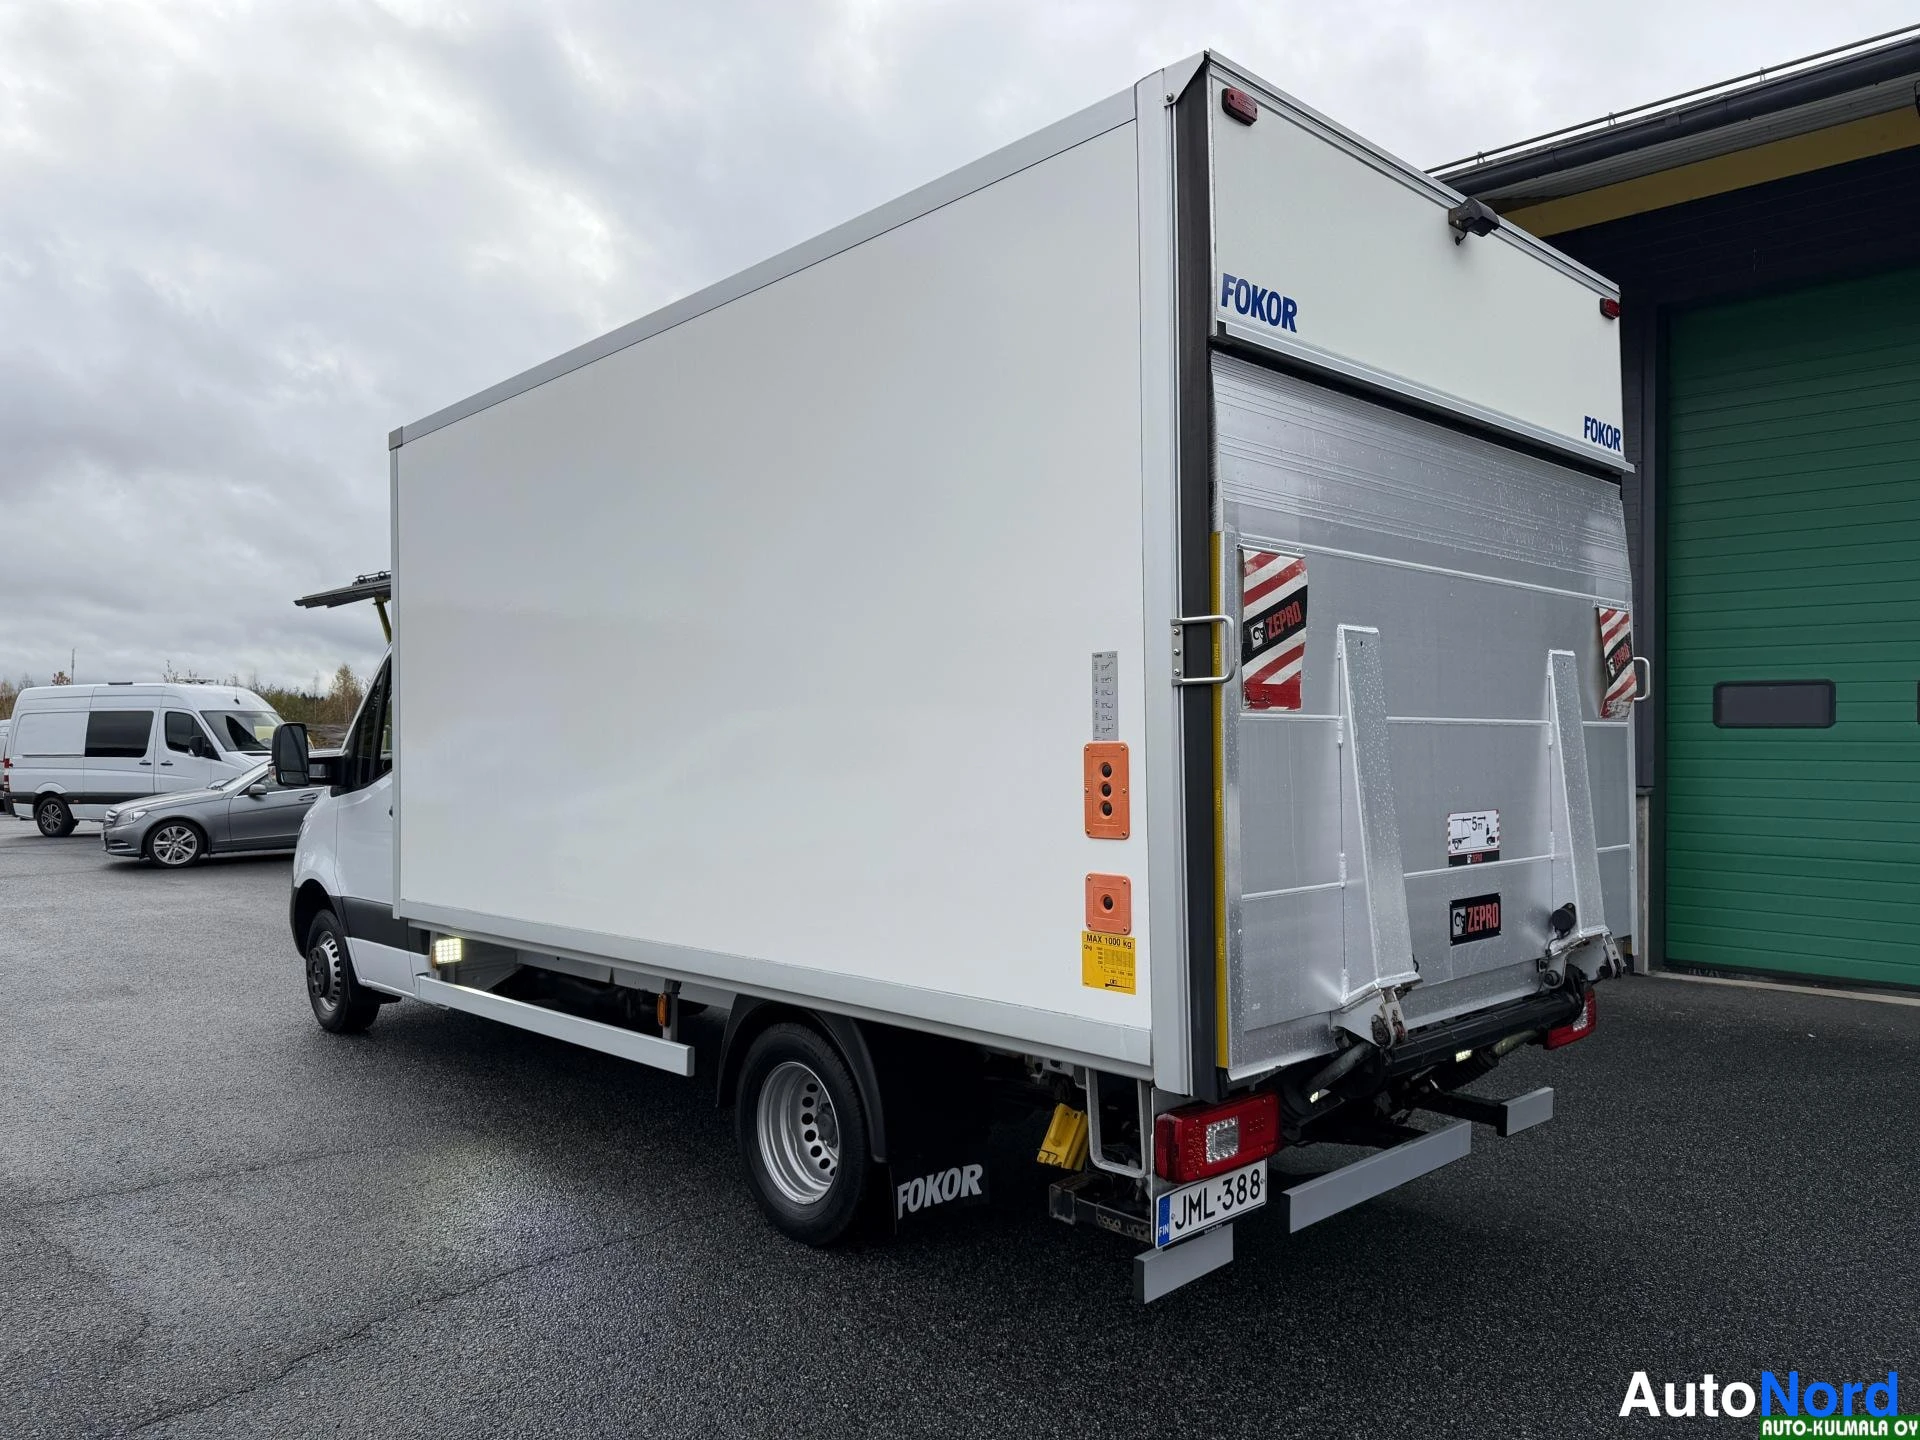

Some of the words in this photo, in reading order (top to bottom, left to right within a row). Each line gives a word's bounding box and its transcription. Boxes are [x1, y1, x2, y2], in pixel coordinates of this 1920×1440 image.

[1221, 272, 1298, 333] FOKOR
[1583, 415, 1621, 452] FOKOR
[1265, 602, 1302, 640] ZEPRO
[1467, 902, 1499, 933] ZEPRO
[1086, 934, 1102, 943] MAX
[1105, 937, 1121, 946] 1000
[1123, 940, 1132, 949] kg
[897, 1163, 983, 1220] FOKOR
[1175, 1168, 1261, 1230] JML-388
[1158, 1223, 1169, 1237] FIN
